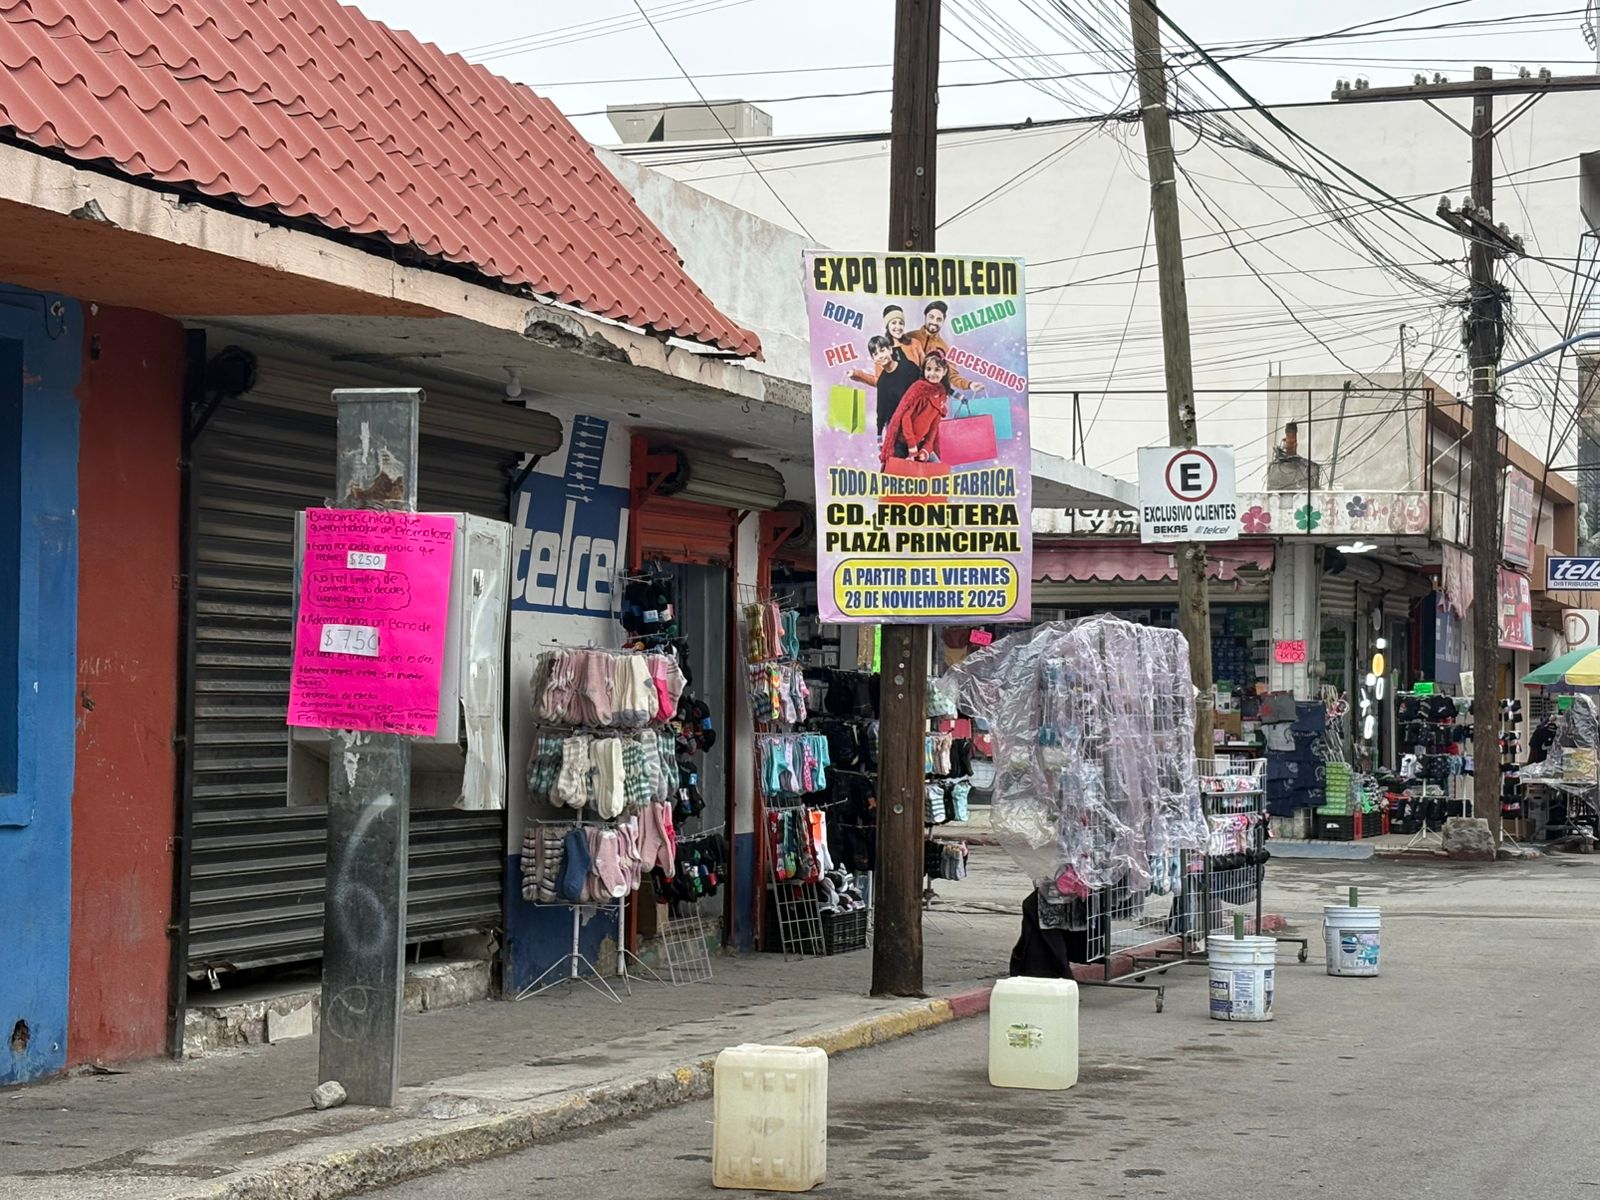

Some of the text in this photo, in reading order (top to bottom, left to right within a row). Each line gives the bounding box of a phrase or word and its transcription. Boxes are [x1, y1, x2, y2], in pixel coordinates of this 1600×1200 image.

[814, 256, 1018, 297] EXPO MOROLEON
[823, 301, 864, 330] ROPA
[950, 300, 1017, 335] CALZADO
[825, 343, 858, 366] PIEL
[946, 347, 1026, 392] ACCESORIOS
[830, 468, 1015, 497] TODO A PRECIO DE FABRICA
[1180, 463, 1202, 491] E
[826, 504, 1019, 526] CD. FRONTERA
[1144, 505, 1192, 522] EXCLUSIVO
[1194, 504, 1236, 520] CLIENTES
[380, 525, 393, 534] de
[1153, 525, 1230, 535] BEKAS telcel
[512, 491, 630, 611] telcel
[826, 532, 1021, 552] PLAZA PRINCIPAL
[349, 553, 381, 566] $250
[842, 567, 1010, 586] A PARTIR DEL VIERNES
[844, 589, 1006, 609] 28 DE NOVIEMBRE 2025
[324, 628, 378, 651] $750
